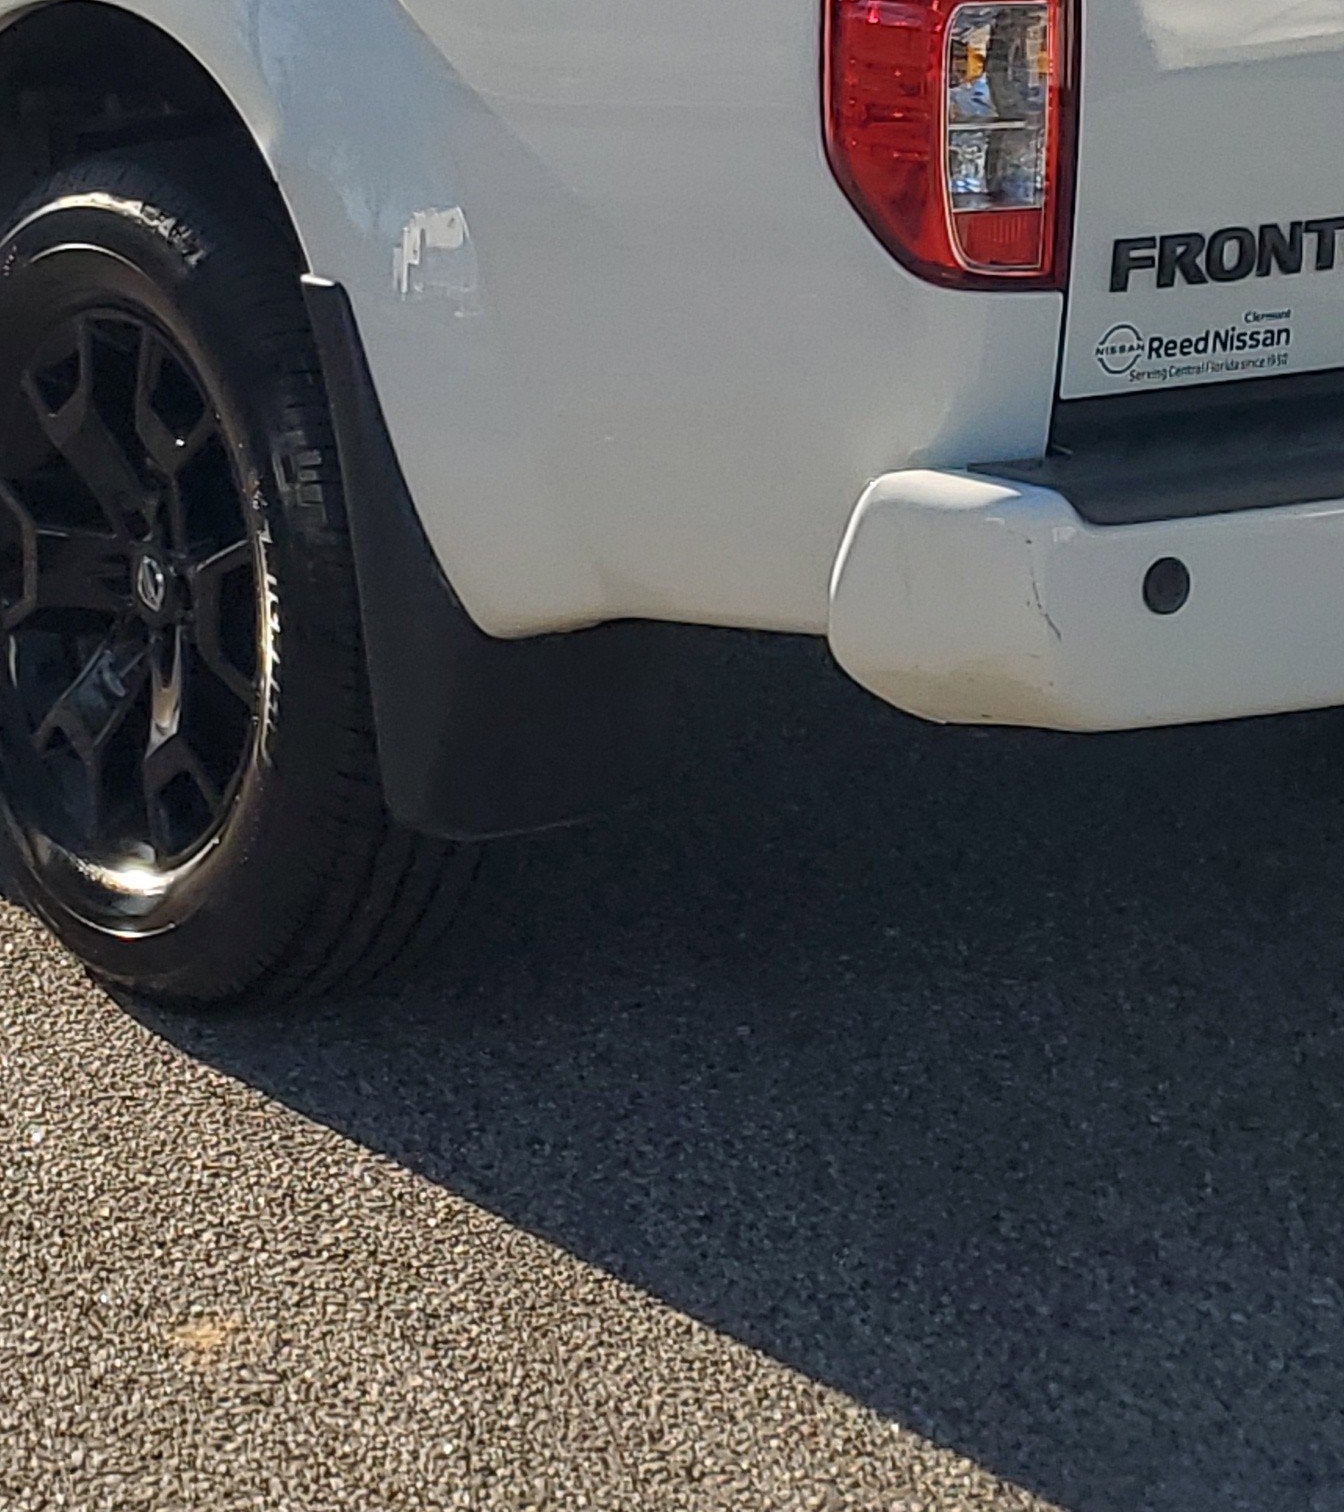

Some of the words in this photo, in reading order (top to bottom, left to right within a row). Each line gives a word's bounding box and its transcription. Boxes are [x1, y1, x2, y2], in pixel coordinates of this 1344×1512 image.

[1095, 343, 1145, 356] NISSAN
[1147, 330, 1210, 360] Reed
[1212, 326, 1291, 355] Nissan
